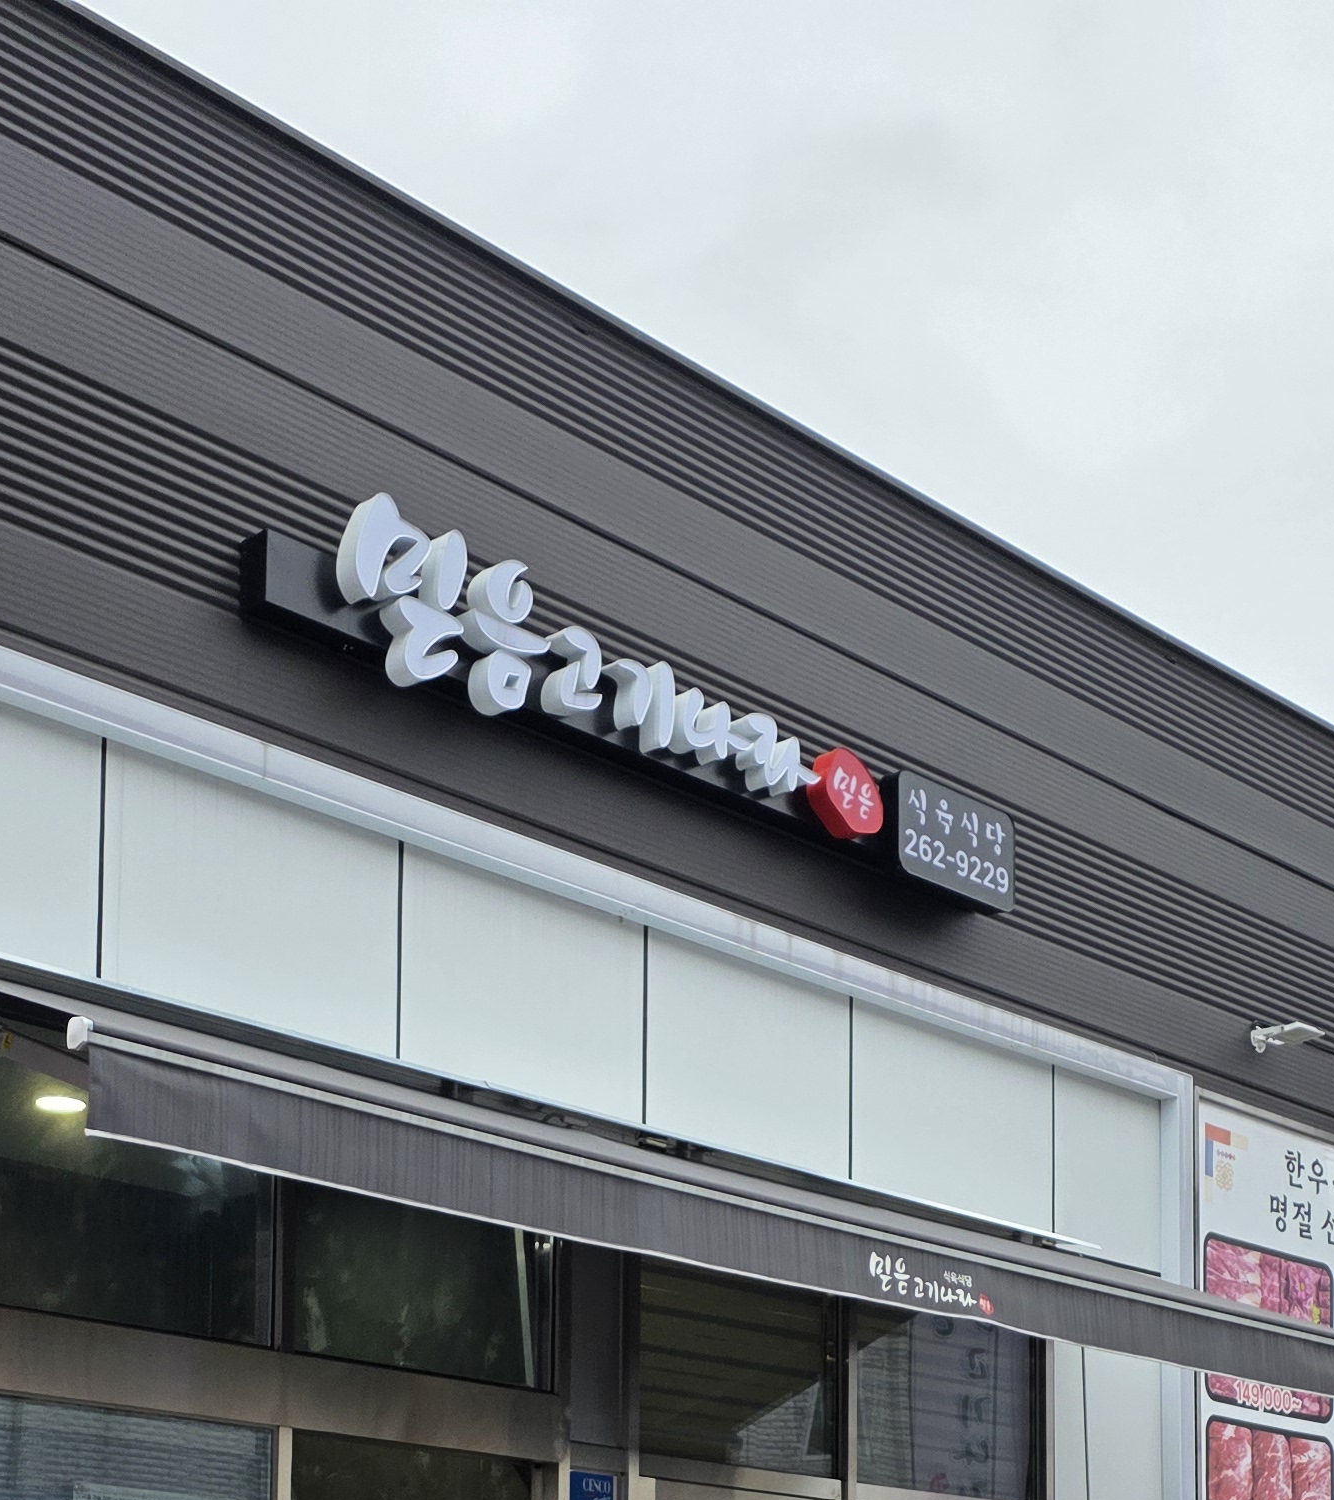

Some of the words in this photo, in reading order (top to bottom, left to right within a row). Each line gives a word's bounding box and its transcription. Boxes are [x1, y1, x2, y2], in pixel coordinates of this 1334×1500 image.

[336, 491, 822, 797] 믿음고기나라
[832, 763, 875, 818] 믿음
[906, 786, 1008, 857] 식육식당
[903, 827, 1011, 896] 262-9229
[1269, 1193, 1312, 1241] 명절
[869, 1251, 977, 1307] 믿음고기나라
